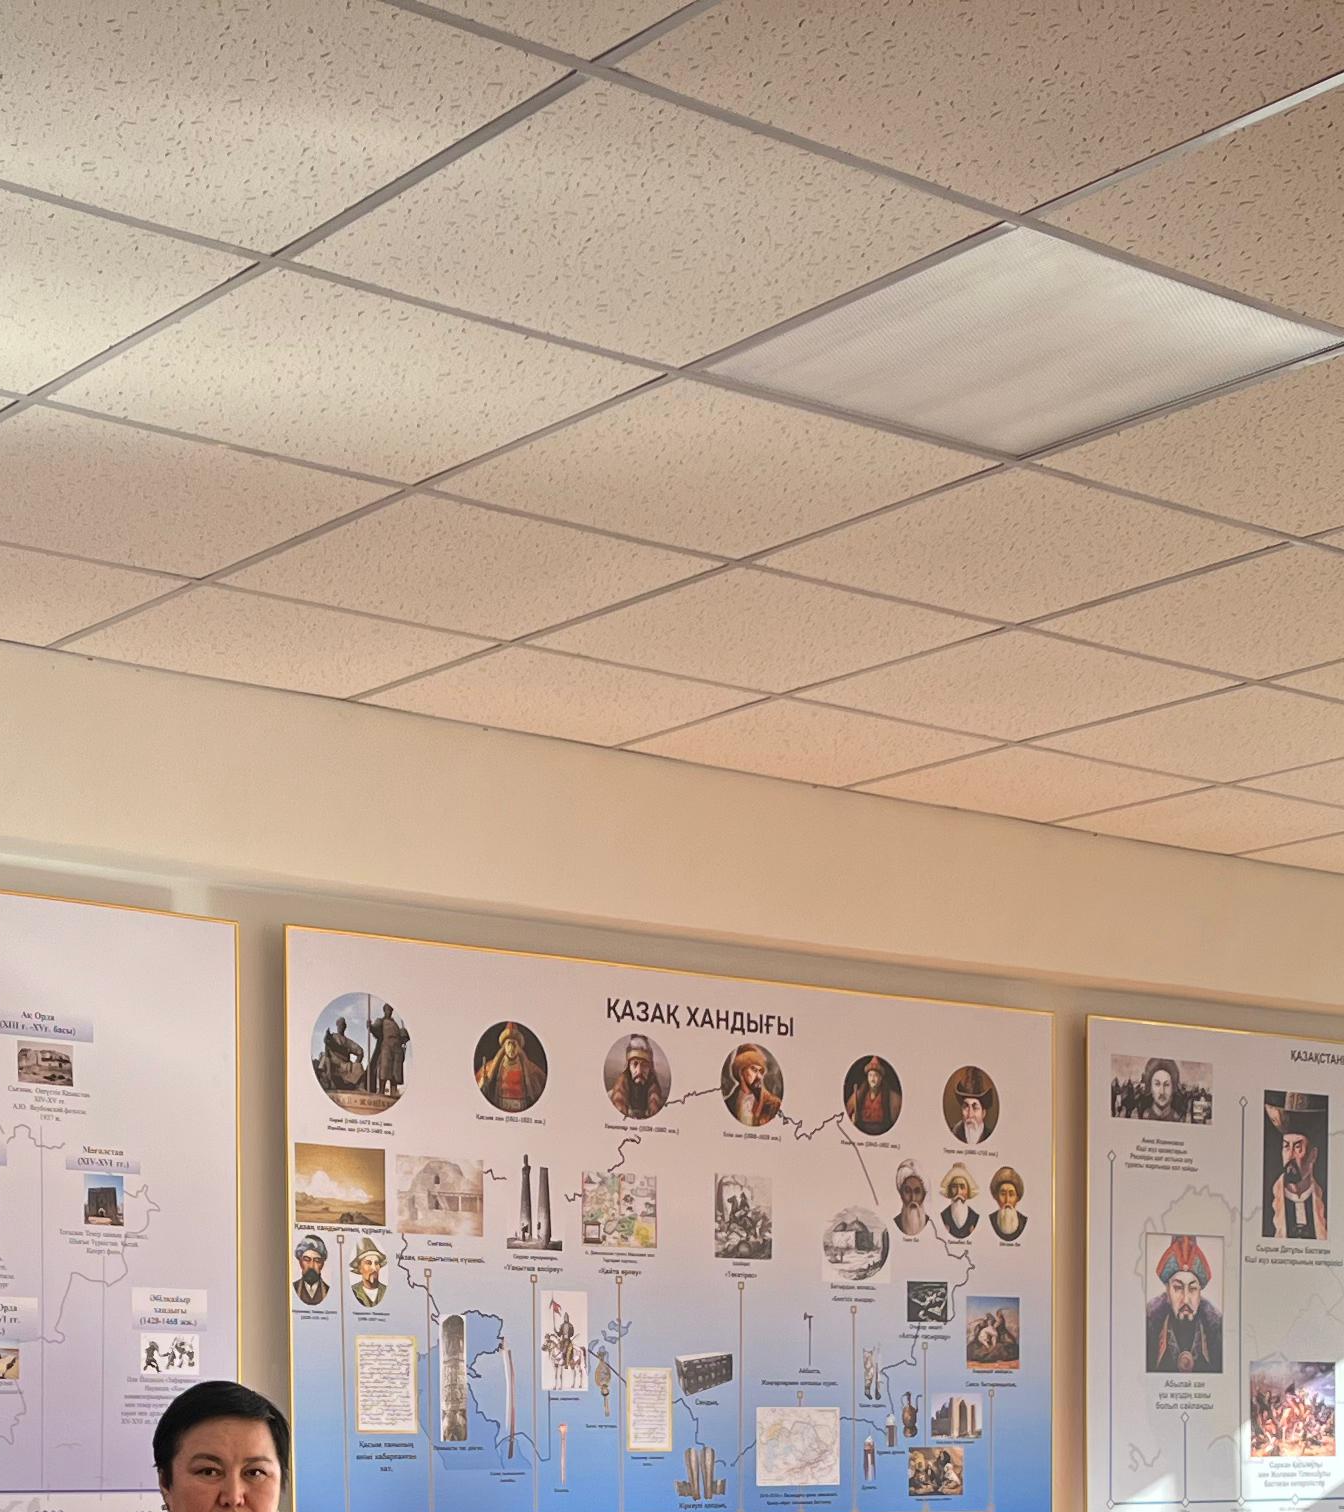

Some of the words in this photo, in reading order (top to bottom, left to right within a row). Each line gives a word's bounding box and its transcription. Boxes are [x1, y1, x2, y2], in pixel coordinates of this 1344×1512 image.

[34, 1011, 55, 1023] Орда
[606, 997, 681, 1029] ҚАЗАҚ
[686, 1005, 795, 1037] ХАНДЫҒЫ
